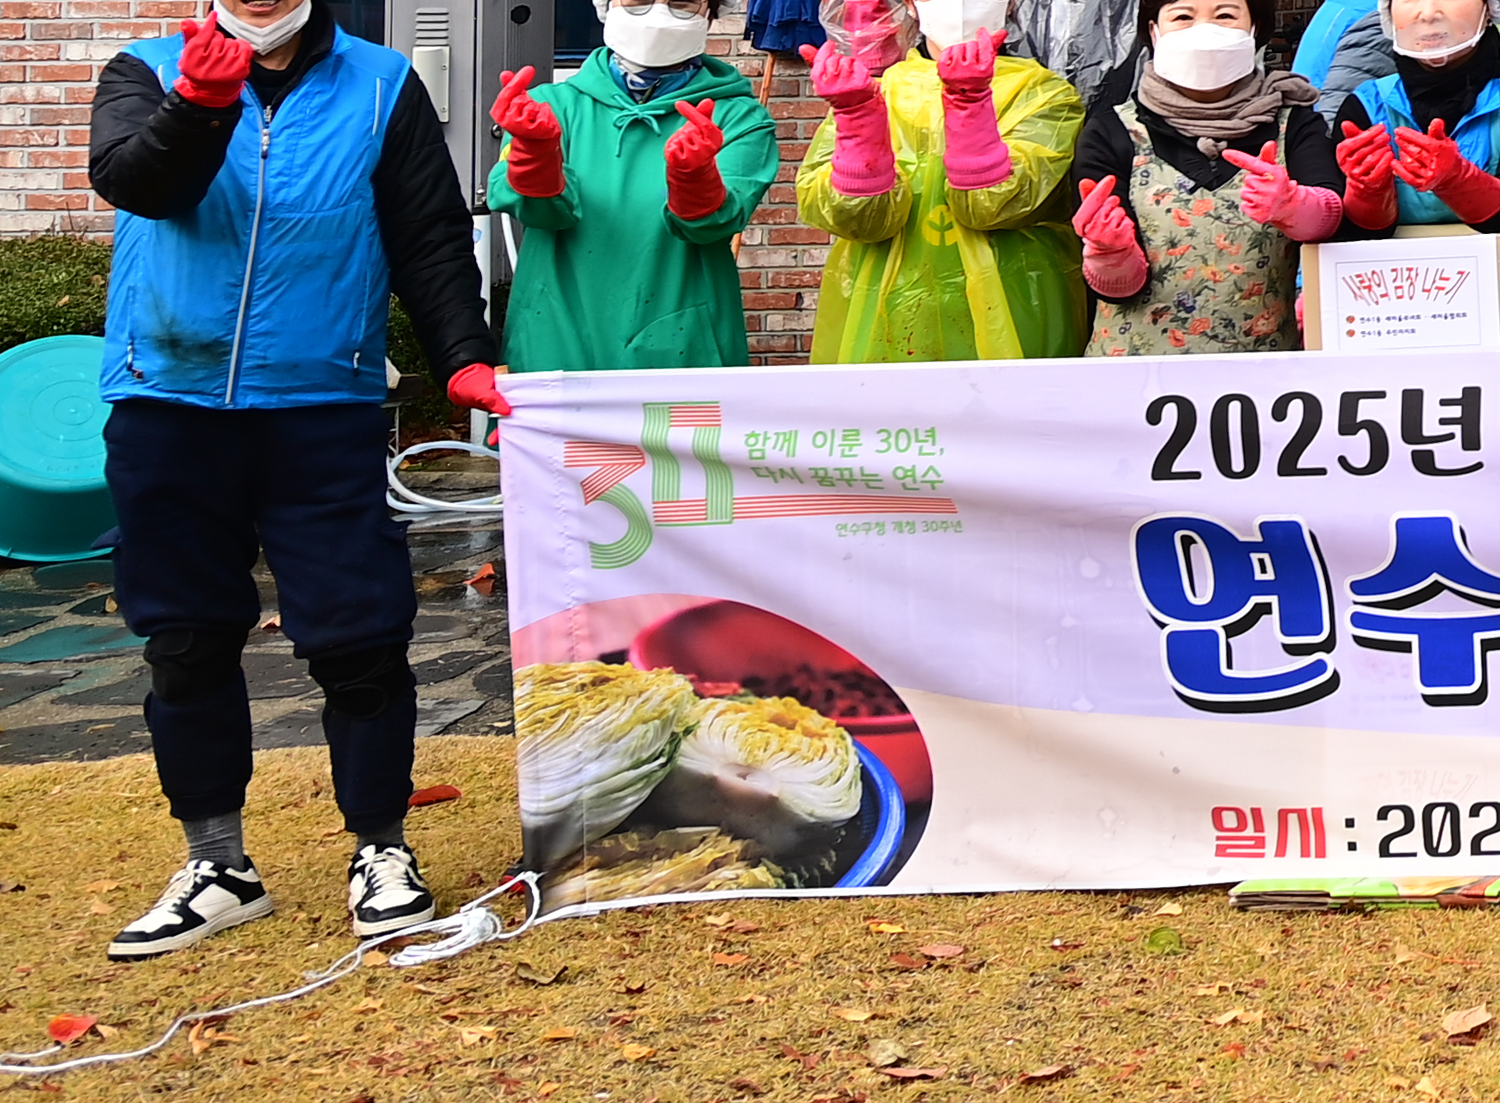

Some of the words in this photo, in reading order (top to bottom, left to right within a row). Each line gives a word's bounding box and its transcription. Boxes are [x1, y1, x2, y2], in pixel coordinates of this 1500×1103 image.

[1342, 270, 1391, 306] 사랑의
[1390, 267, 1419, 301] 김장
[1422, 267, 1471, 304] 나누기
[744, 429, 798, 459] 함께
[811, 428, 863, 459] 이룬
[876, 426, 946, 457] 30년,
[1144, 385, 1485, 481] 2025년
[751, 465, 804, 486] 다시
[810, 466, 883, 491] 꿈꾸는
[892, 464, 945, 491] 연수
